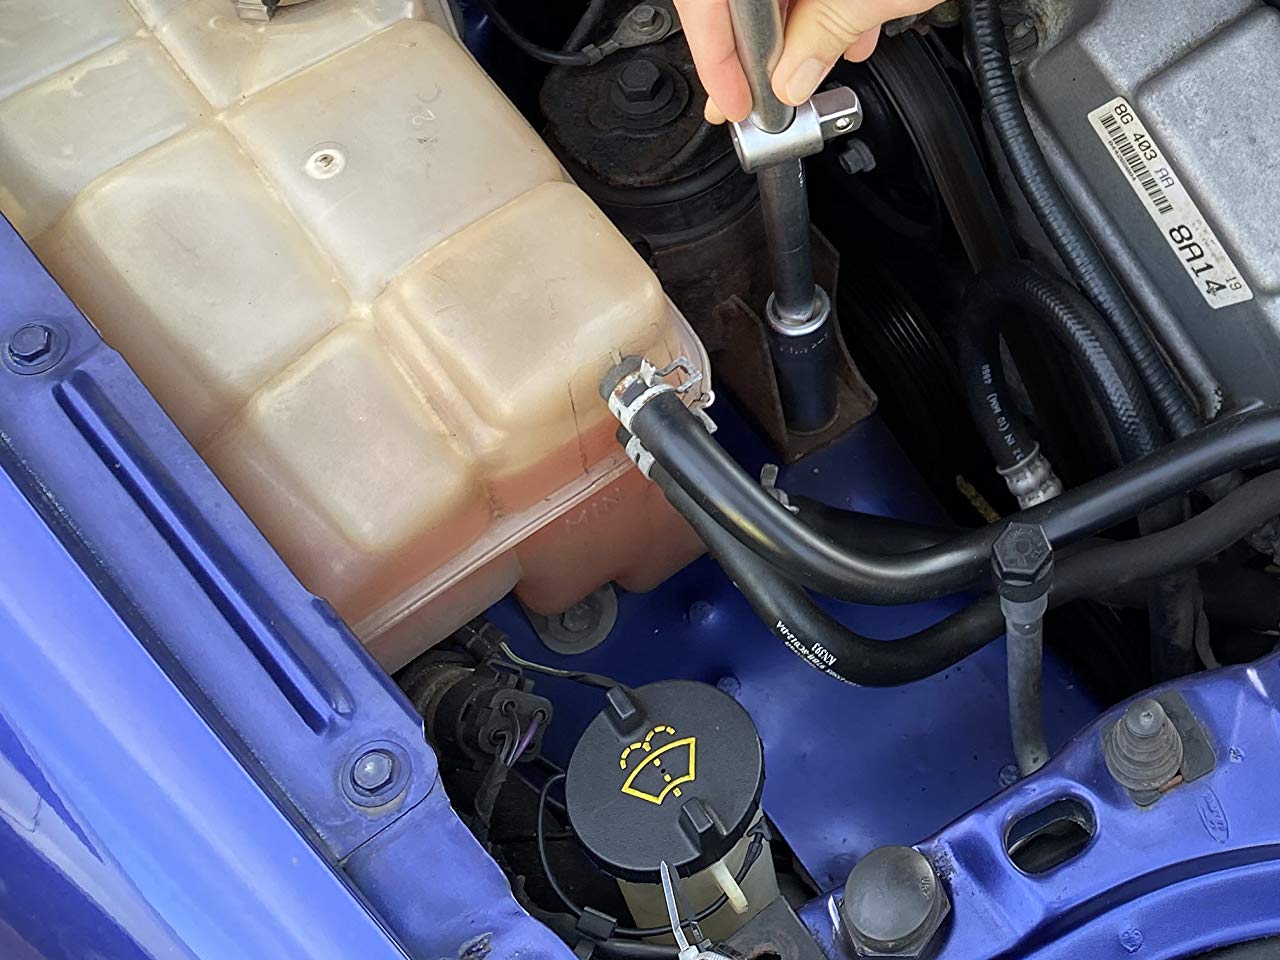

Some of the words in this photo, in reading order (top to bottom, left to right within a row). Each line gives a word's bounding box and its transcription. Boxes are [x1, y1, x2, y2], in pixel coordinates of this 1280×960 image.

[1131, 129, 1157, 162] 403
[1154, 165, 1175, 189] AA
[1167, 221, 1226, 298] 8A14
[1225, 273, 1242, 291] 19
[810, 641, 837, 665] KN393
